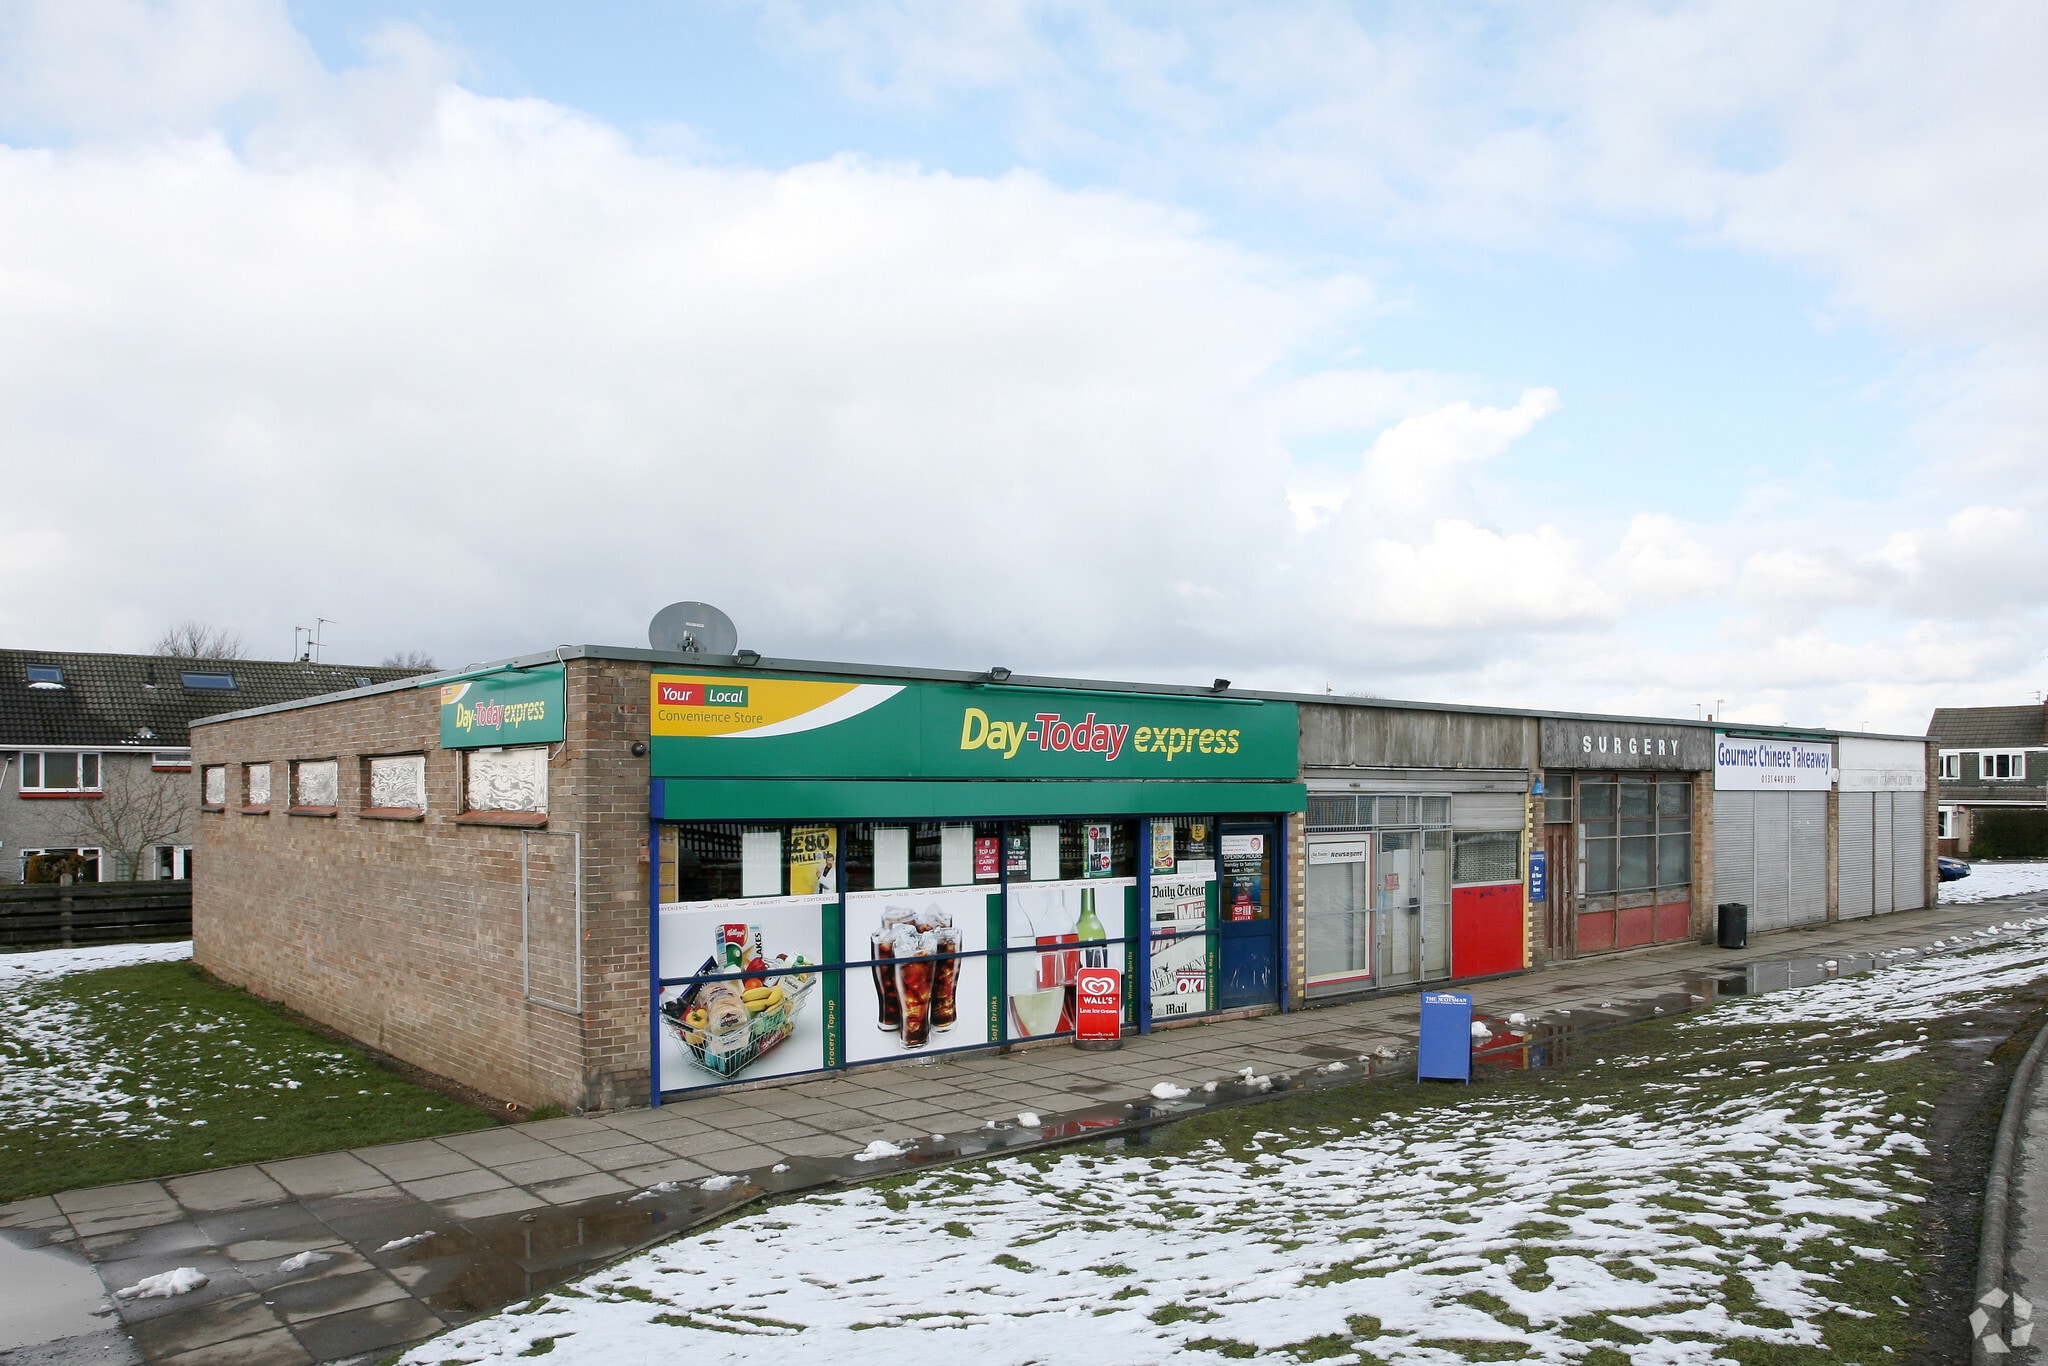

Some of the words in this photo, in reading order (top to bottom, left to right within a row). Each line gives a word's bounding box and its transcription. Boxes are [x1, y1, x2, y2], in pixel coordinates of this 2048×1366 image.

[662, 687, 692, 700] Your
[709, 690, 743, 703] Local
[456, 699, 504, 734] Day-Today
[504, 701, 545, 728] express
[658, 710, 731, 723] Convenience
[734, 712, 763, 724] Store
[960, 708, 1129, 761] Day-Today
[1134, 726, 1240, 761] express
[1583, 735, 1678, 756] SURGERY
[1718, 742, 1757, 767] Gourmet
[1758, 744, 1791, 768] Chinese
[1791, 746, 1830, 775] Takeaway
[1761, 774, 1773, 784] 0131
[1773, 775, 1784, 784] 440
[791, 833, 829, 853] £80
[1152, 885, 1175, 899] Daily
[1177, 978, 1204, 994] OK!
[827, 1000, 835, 1029] Top-up
[1166, 1002, 1187, 1015] Mail
[828, 1032, 836, 1067] Grocery
